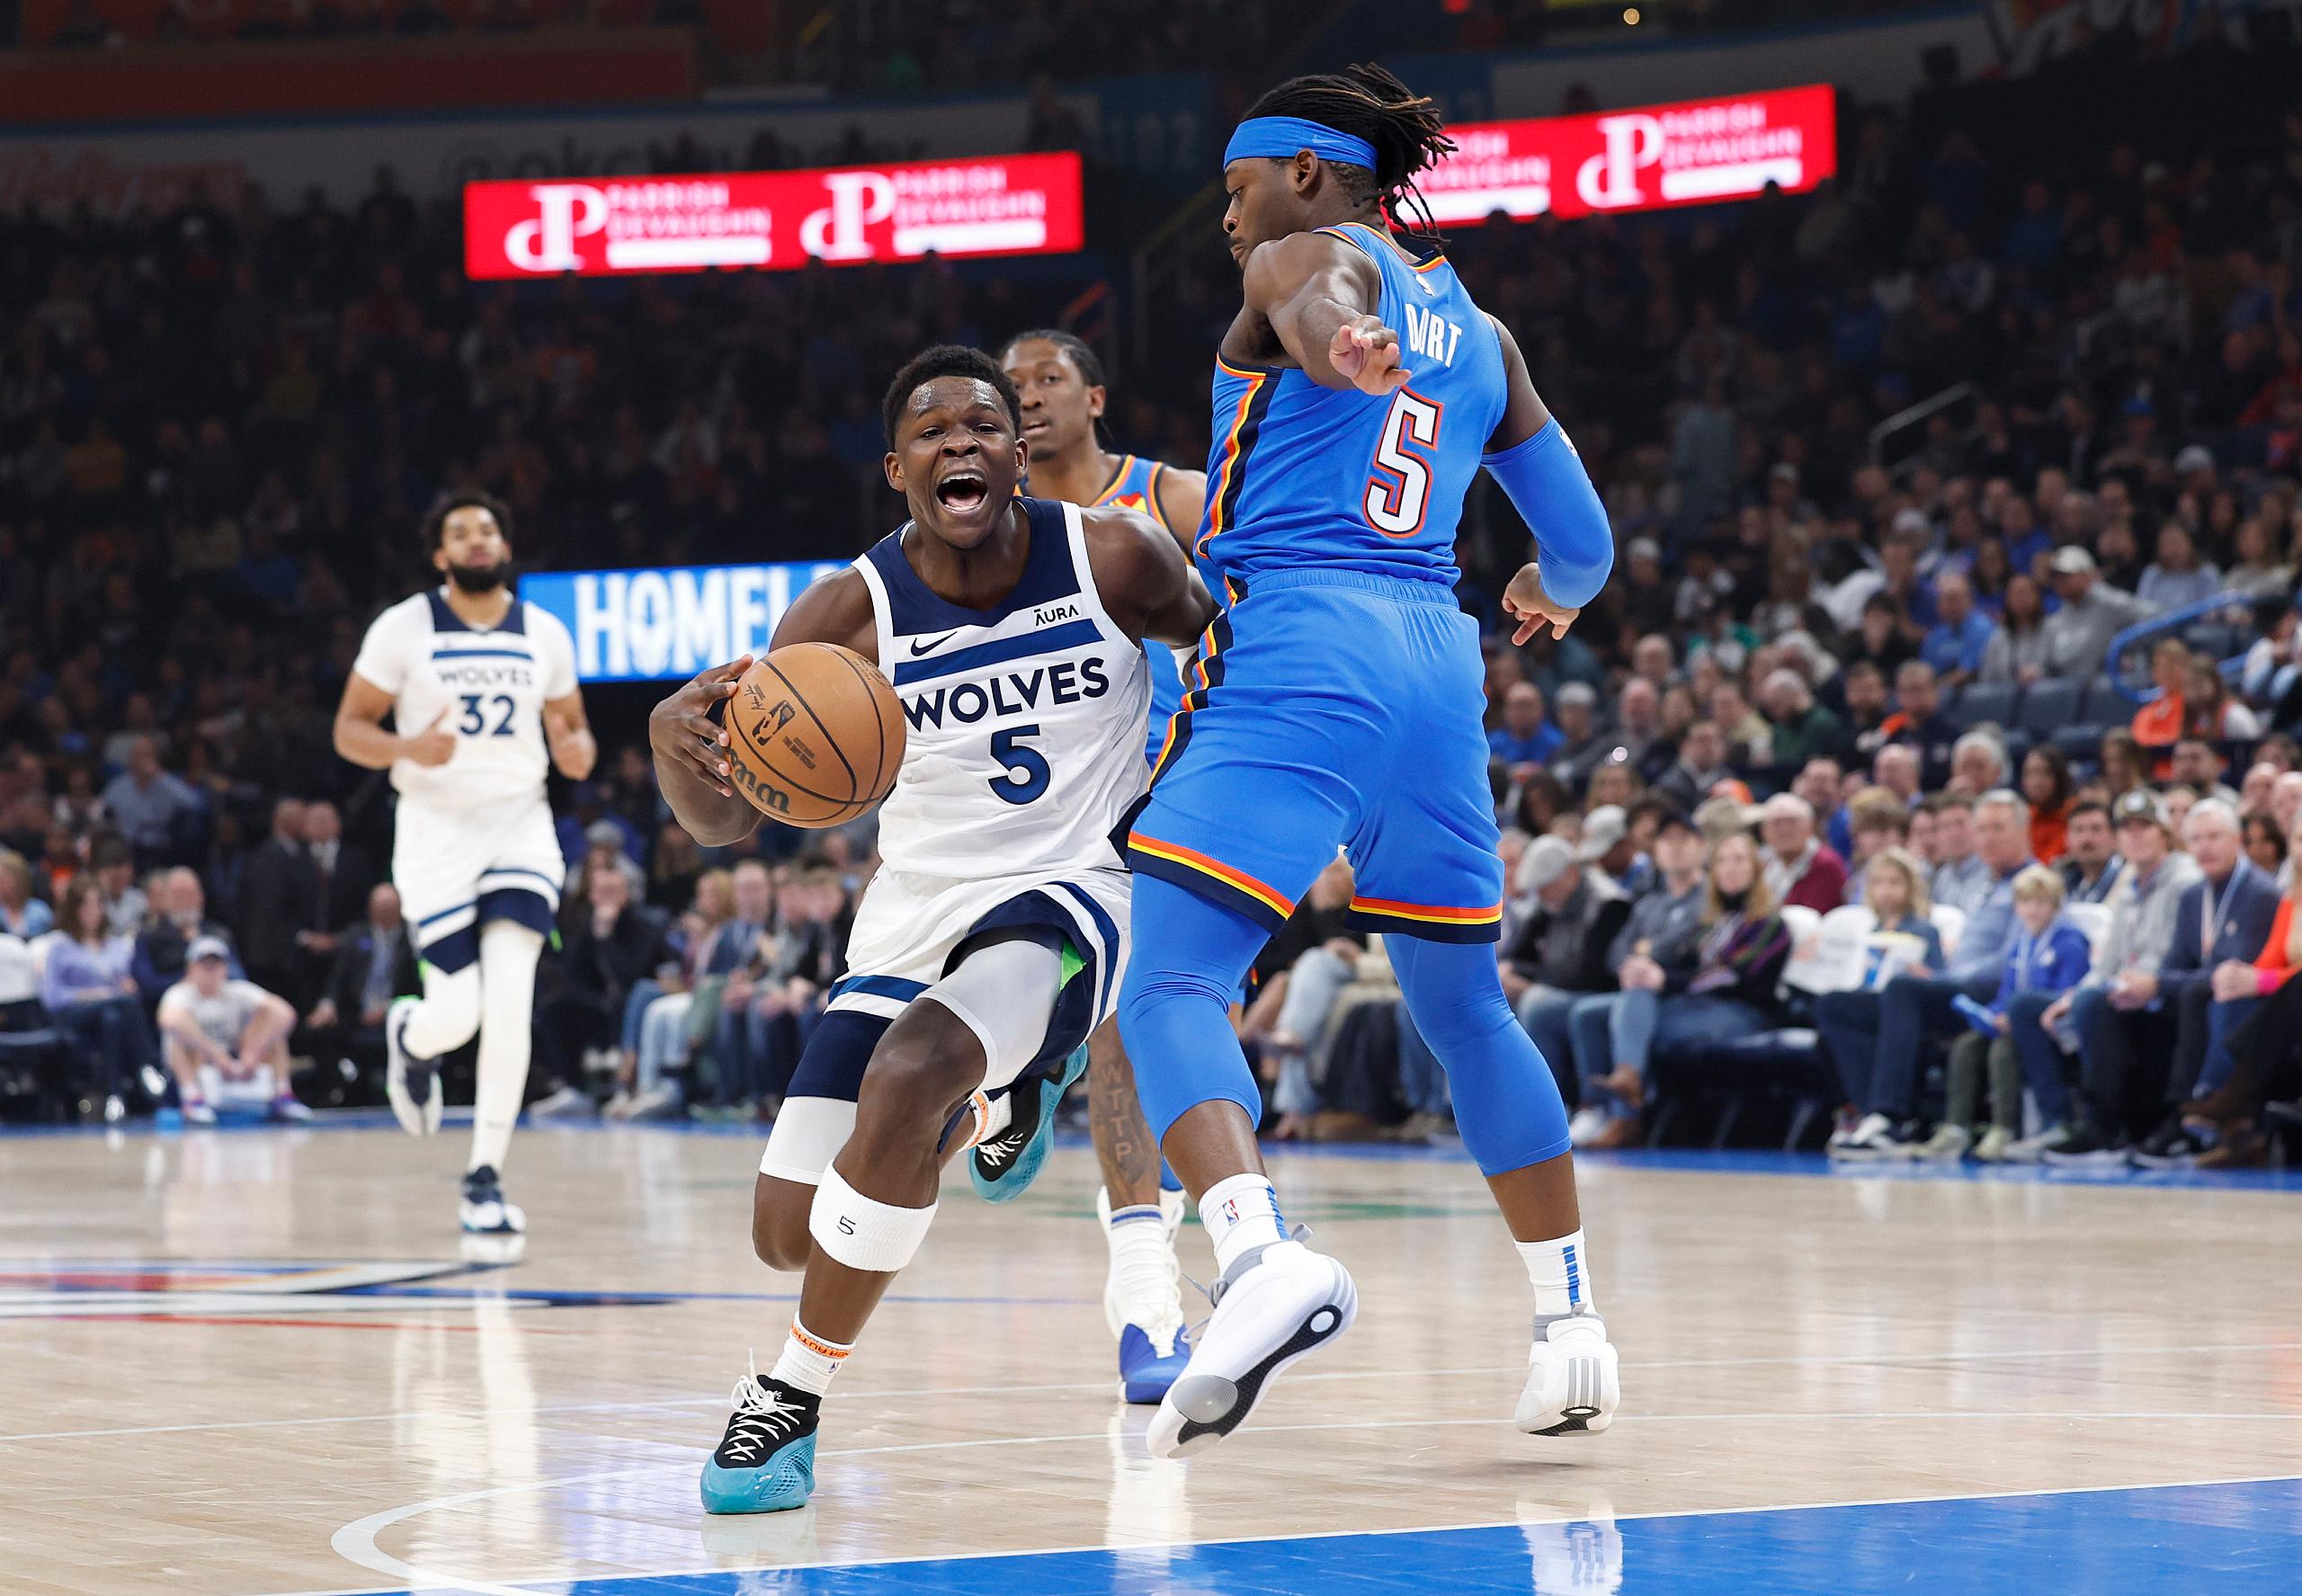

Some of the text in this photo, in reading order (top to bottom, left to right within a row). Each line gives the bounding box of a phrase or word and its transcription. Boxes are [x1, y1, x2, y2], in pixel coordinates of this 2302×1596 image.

[1405, 302, 1463, 369] DORT
[1363, 385, 1444, 539] 5
[438, 666, 532, 686] WOLVES
[900, 656, 1110, 732] WOLVES
[460, 694, 515, 736] 32
[988, 723, 1051, 806] 5
[836, 1215, 857, 1236] 5
